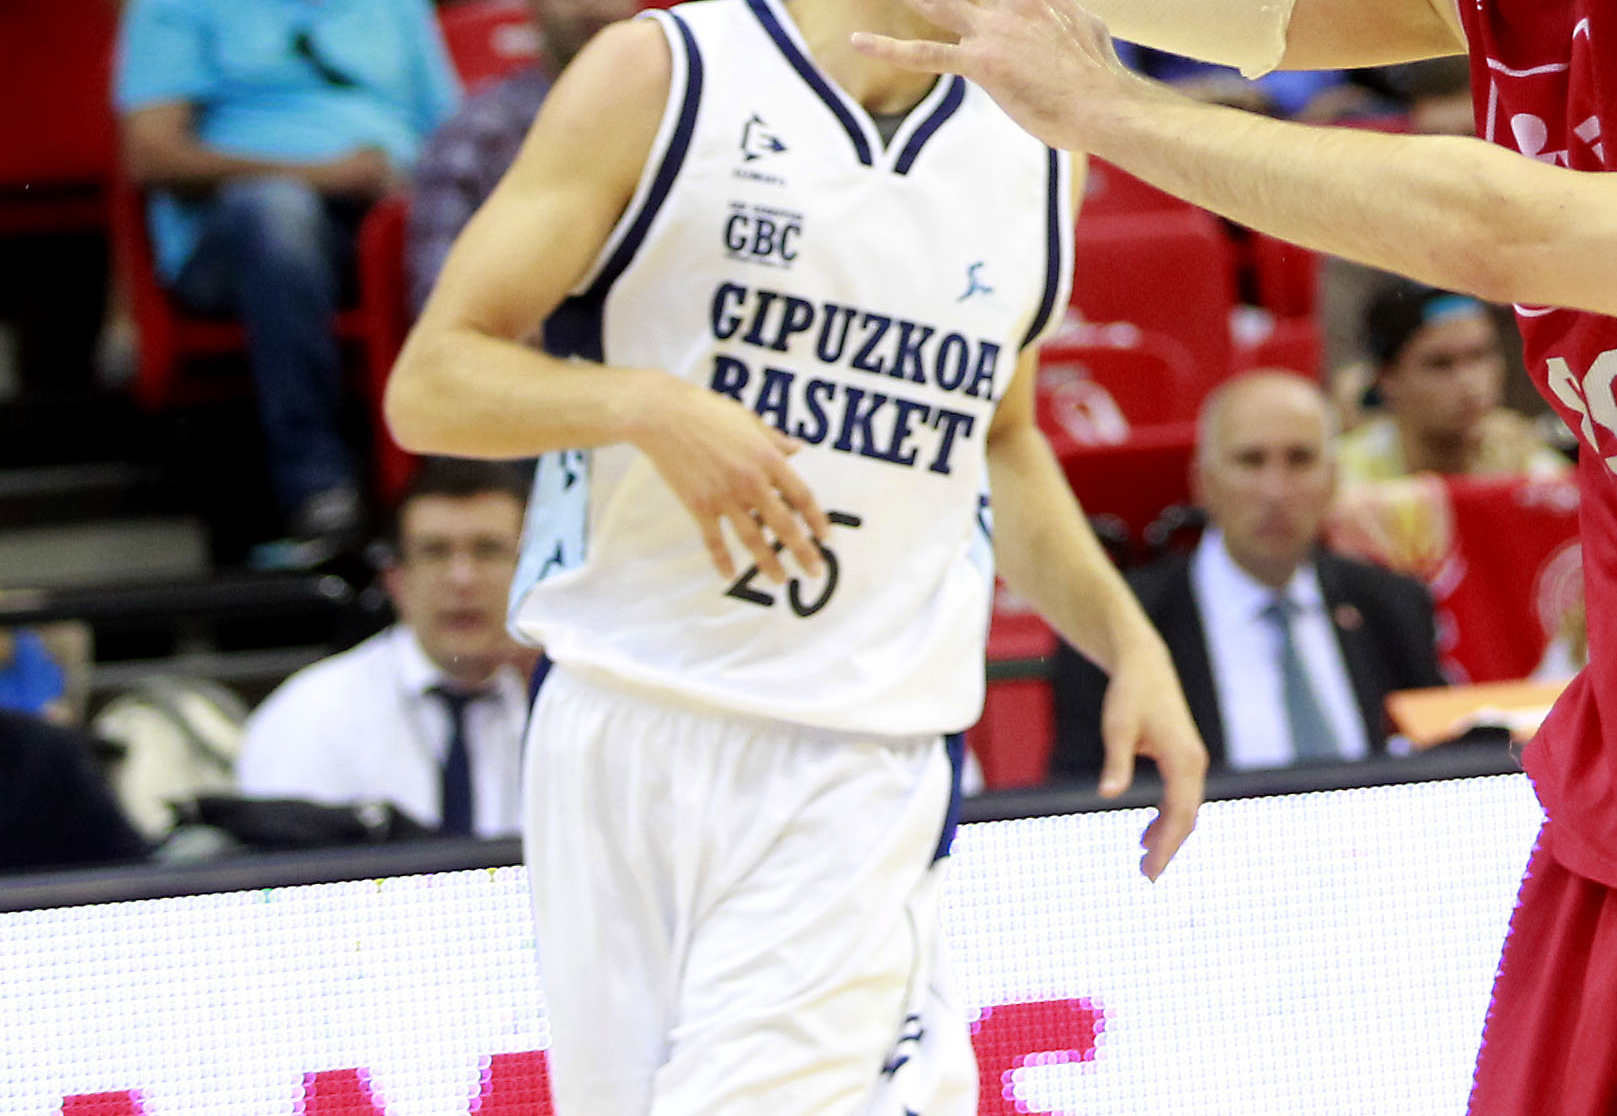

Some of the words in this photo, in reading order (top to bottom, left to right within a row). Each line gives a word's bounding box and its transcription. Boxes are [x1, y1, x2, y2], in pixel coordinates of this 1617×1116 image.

[724, 213, 802, 262] GBC
[710, 281, 1000, 401] GIPUZKOA
[710, 354, 975, 475] BASKET
